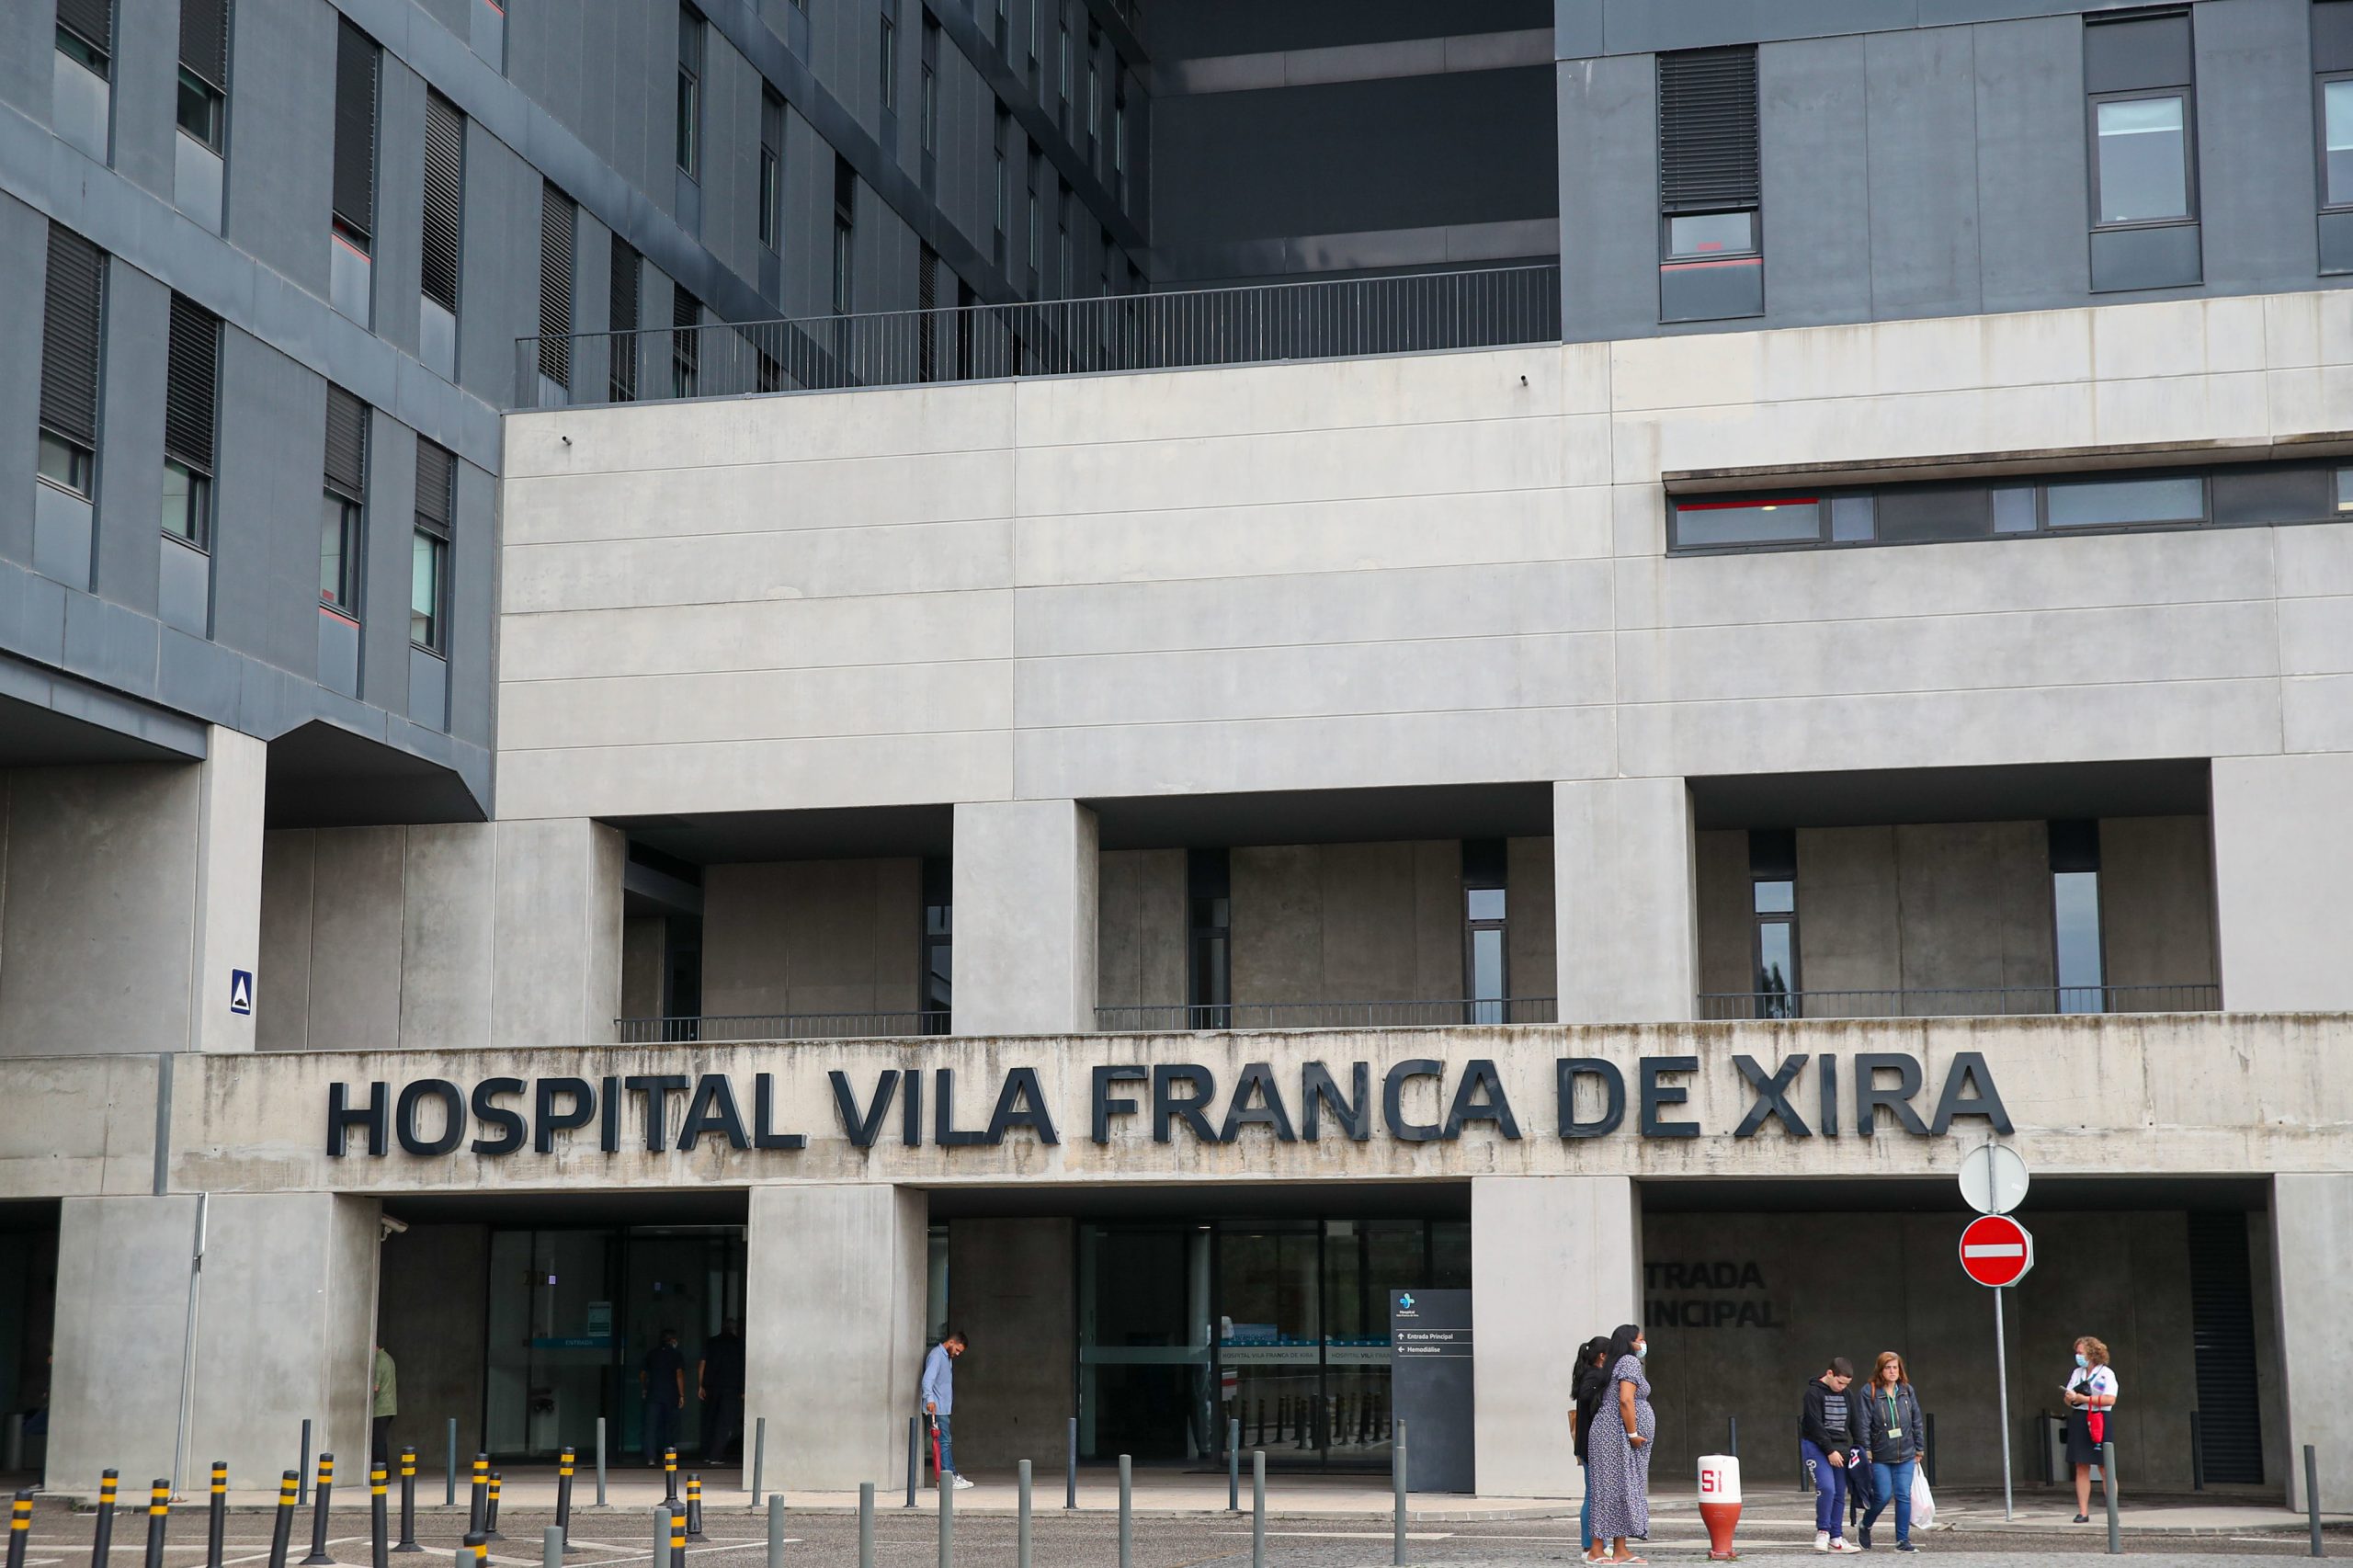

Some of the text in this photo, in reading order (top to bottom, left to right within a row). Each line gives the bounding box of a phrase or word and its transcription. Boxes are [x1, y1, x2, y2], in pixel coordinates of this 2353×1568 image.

[326, 1051, 2017, 1158] HOSPITAL VILA FRANCA DE XIRA
[1643, 1262, 1766, 1290] TRADA
[1644, 1299, 1785, 1328] INCIPAL
[1430, 1333, 1453, 1341] Principal
